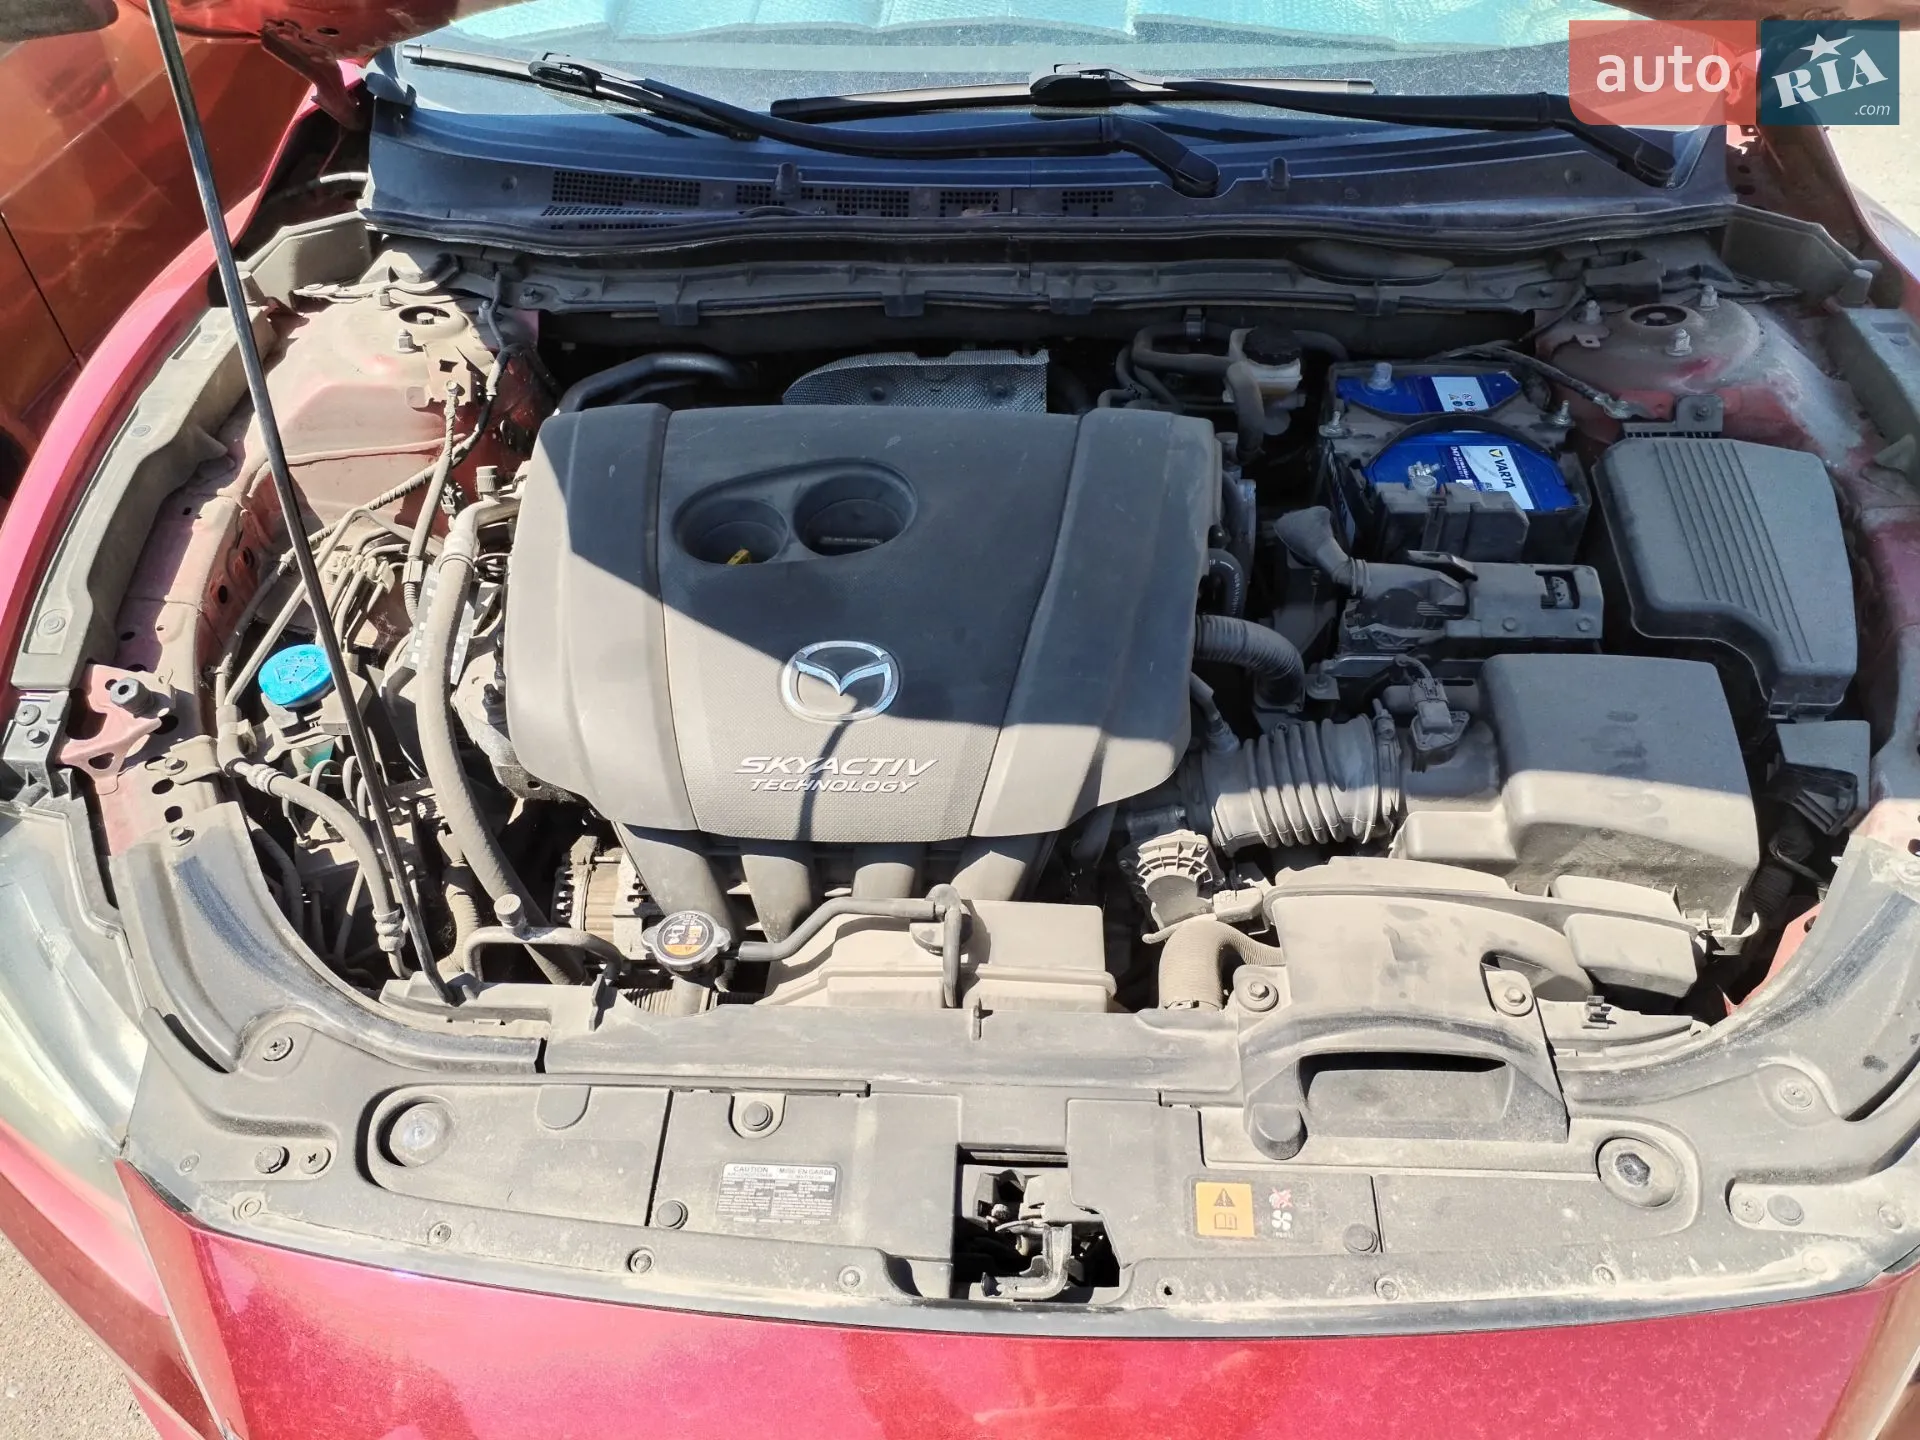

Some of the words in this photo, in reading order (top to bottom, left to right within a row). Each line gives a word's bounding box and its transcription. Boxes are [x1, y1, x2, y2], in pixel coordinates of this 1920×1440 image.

[1494, 459, 1516, 489] VARTA
[734, 756, 939, 777] SKYACTIV
[750, 778, 919, 794] TECHNOLOGY
[809, 1168, 833, 1176] GARDE
